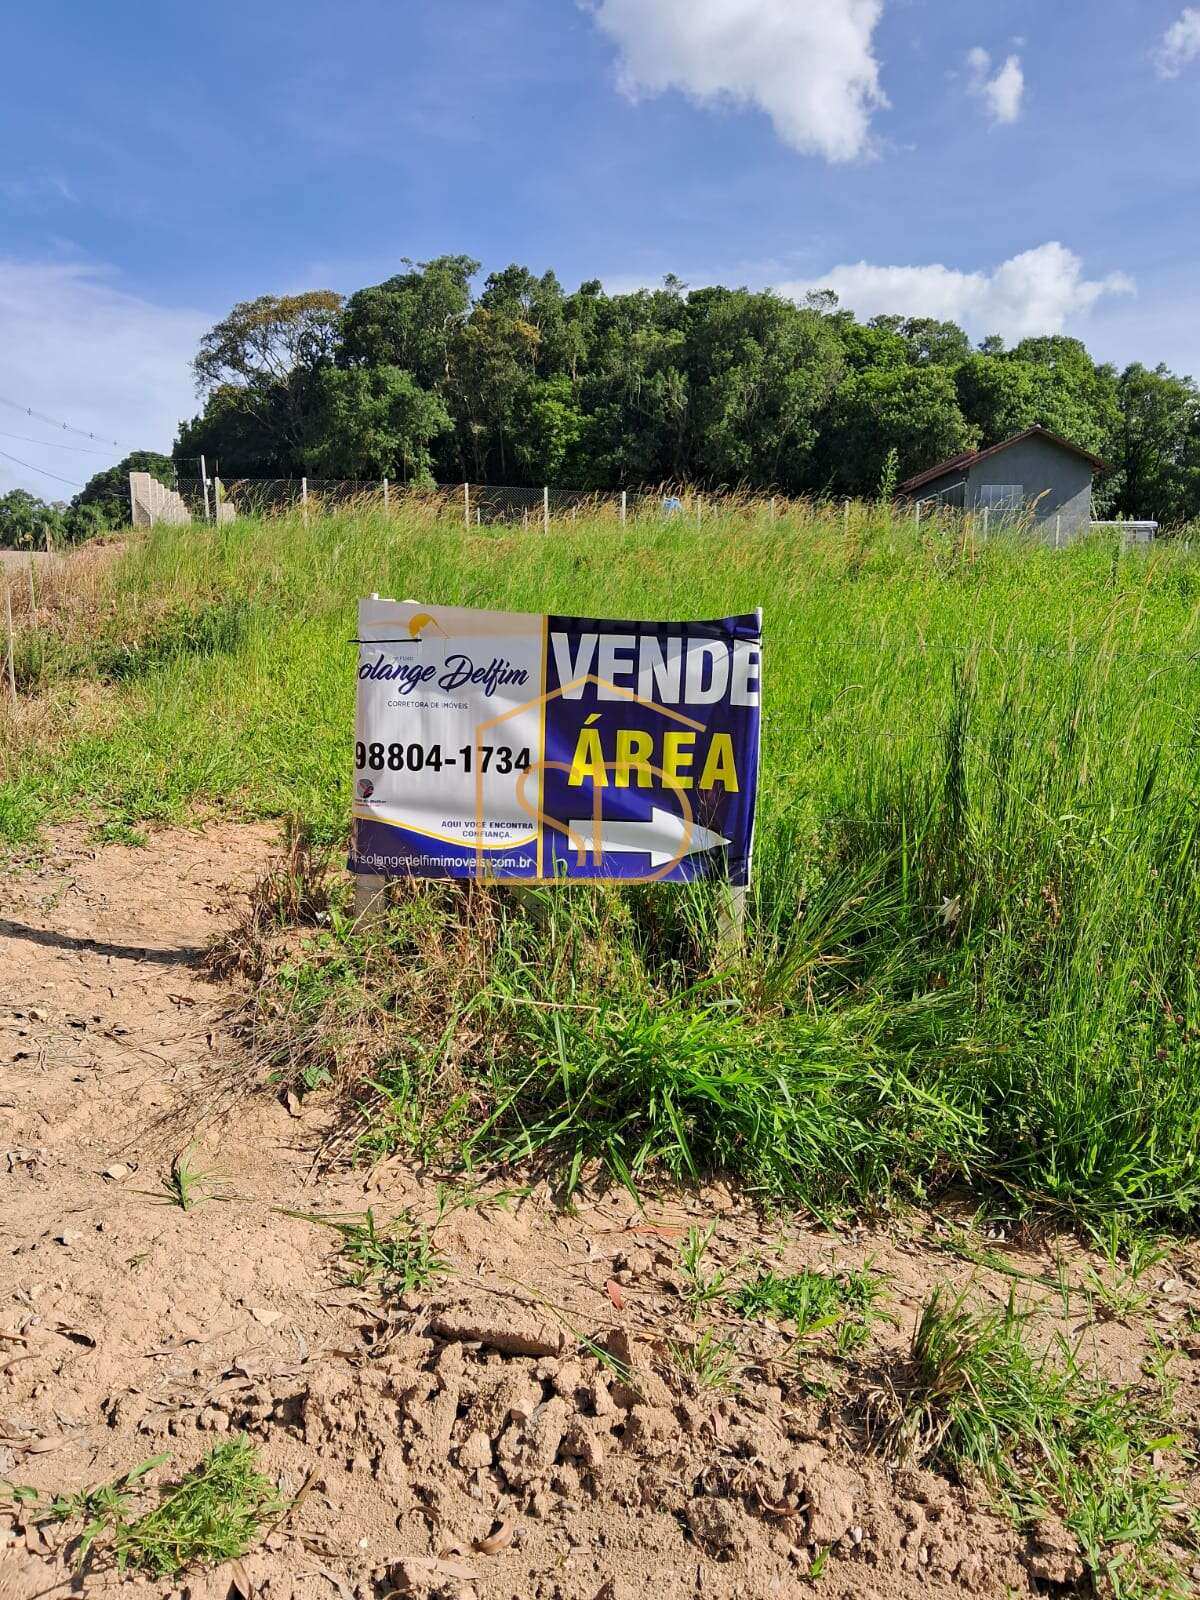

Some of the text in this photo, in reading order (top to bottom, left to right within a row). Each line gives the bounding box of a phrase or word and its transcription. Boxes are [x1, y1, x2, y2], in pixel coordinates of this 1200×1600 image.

[359, 653, 530, 698] olange Delfim
[550, 631, 761, 708] VENDE
[387, 700, 429, 709] CORRETORA
[430, 701, 440, 709] DE
[355, 741, 532, 775] 98804-1734
[567, 713, 740, 793] ÁREA
[441, 820, 462, 829] AQUI
[489, 821, 534, 831] ENCONTRA
[462, 830, 512, 840] CONFIANÇA.
